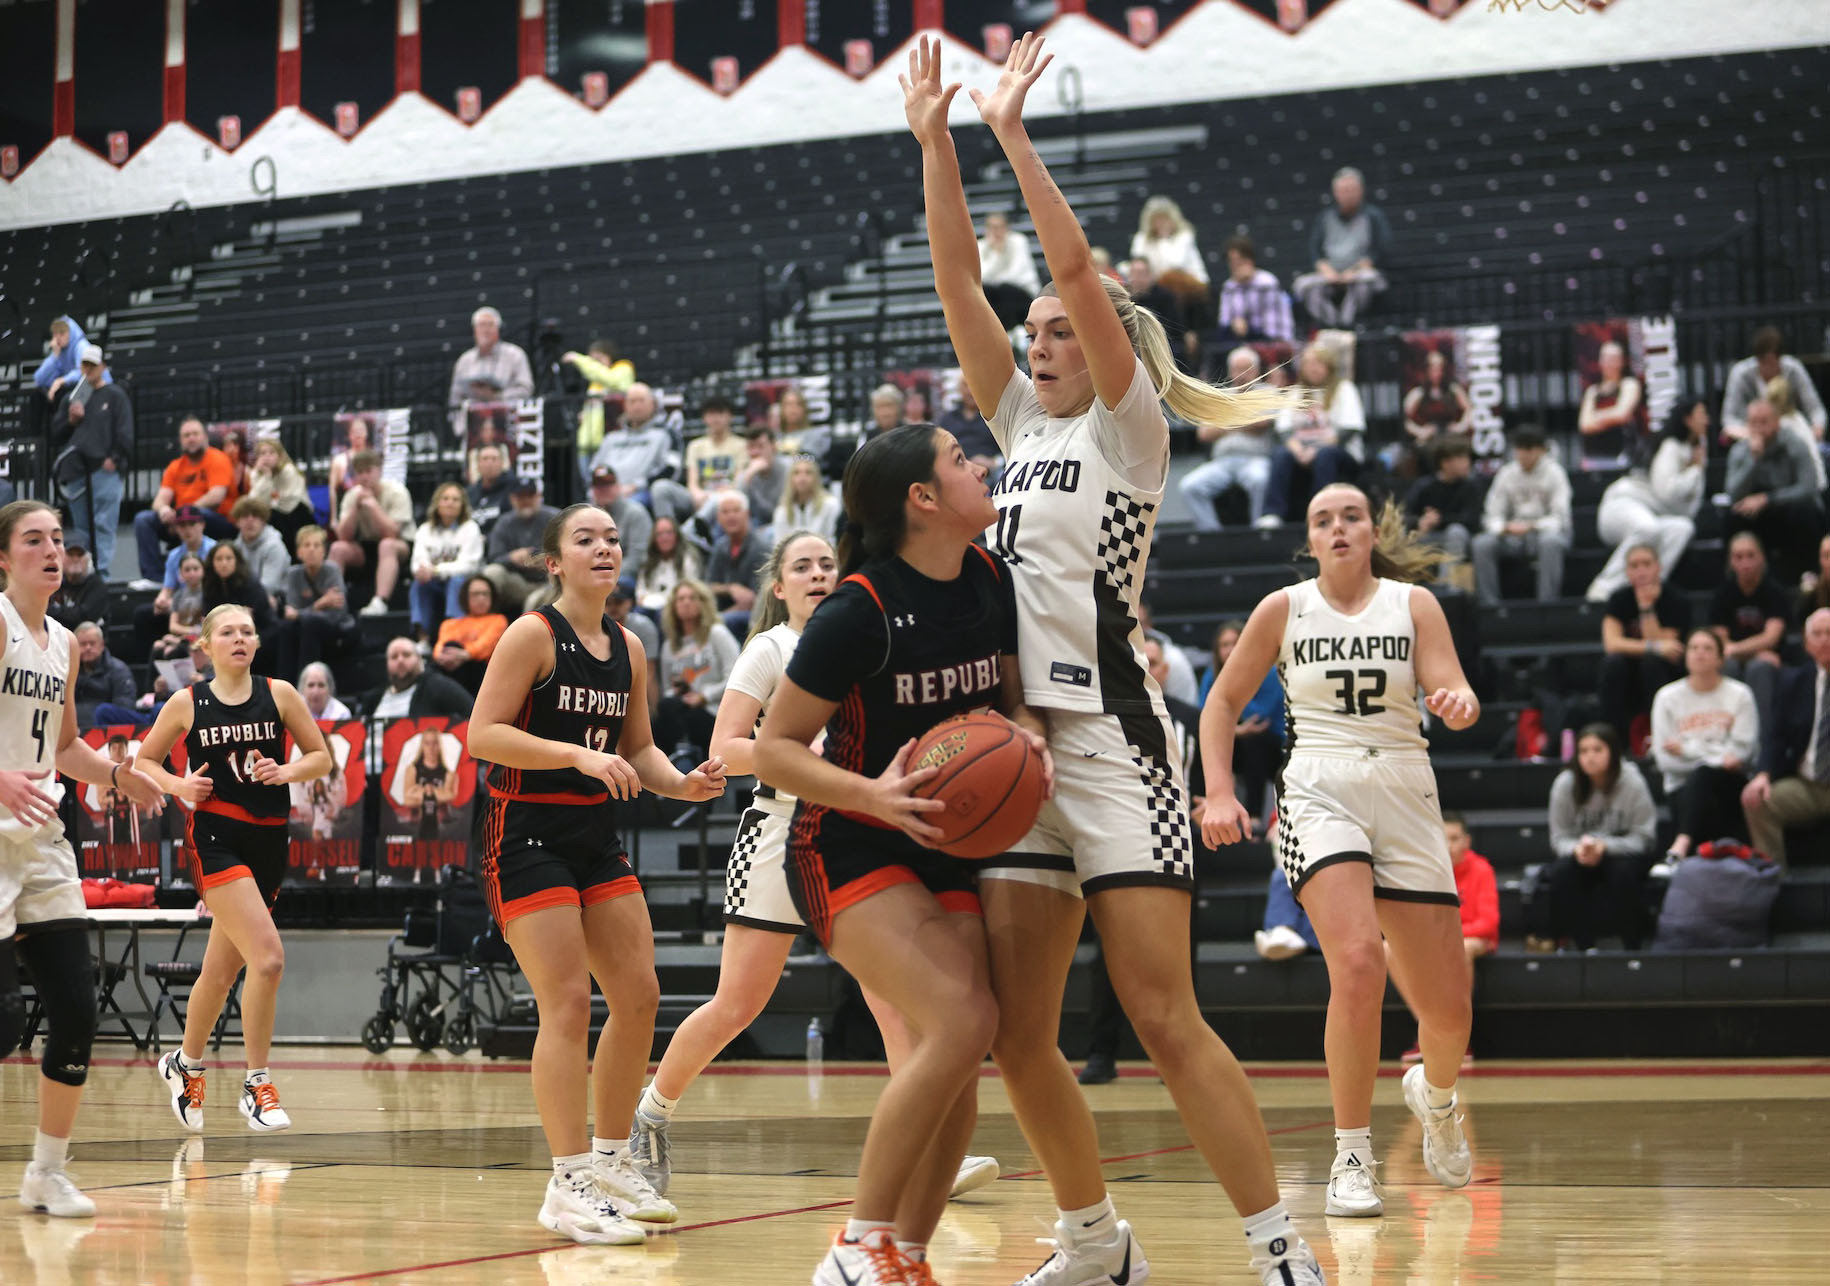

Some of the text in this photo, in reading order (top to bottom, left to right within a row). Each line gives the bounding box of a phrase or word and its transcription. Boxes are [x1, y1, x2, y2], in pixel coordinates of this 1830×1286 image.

[1466, 324, 1506, 456] SPOHN
[994, 459, 1081, 495] KAPOO
[995, 504, 1023, 566] 11
[1293, 635, 1411, 667] KICKAPOO
[1, 666, 66, 706] KICKAPO
[895, 651, 1001, 705] REPUBL
[1077, 671, 1088, 682] M
[1325, 669, 1387, 717] 32
[557, 684, 630, 718] REPUBLI
[31, 708, 49, 764] 4
[198, 721, 277, 748] REPUBLIC
[227, 749, 260, 784] 14
